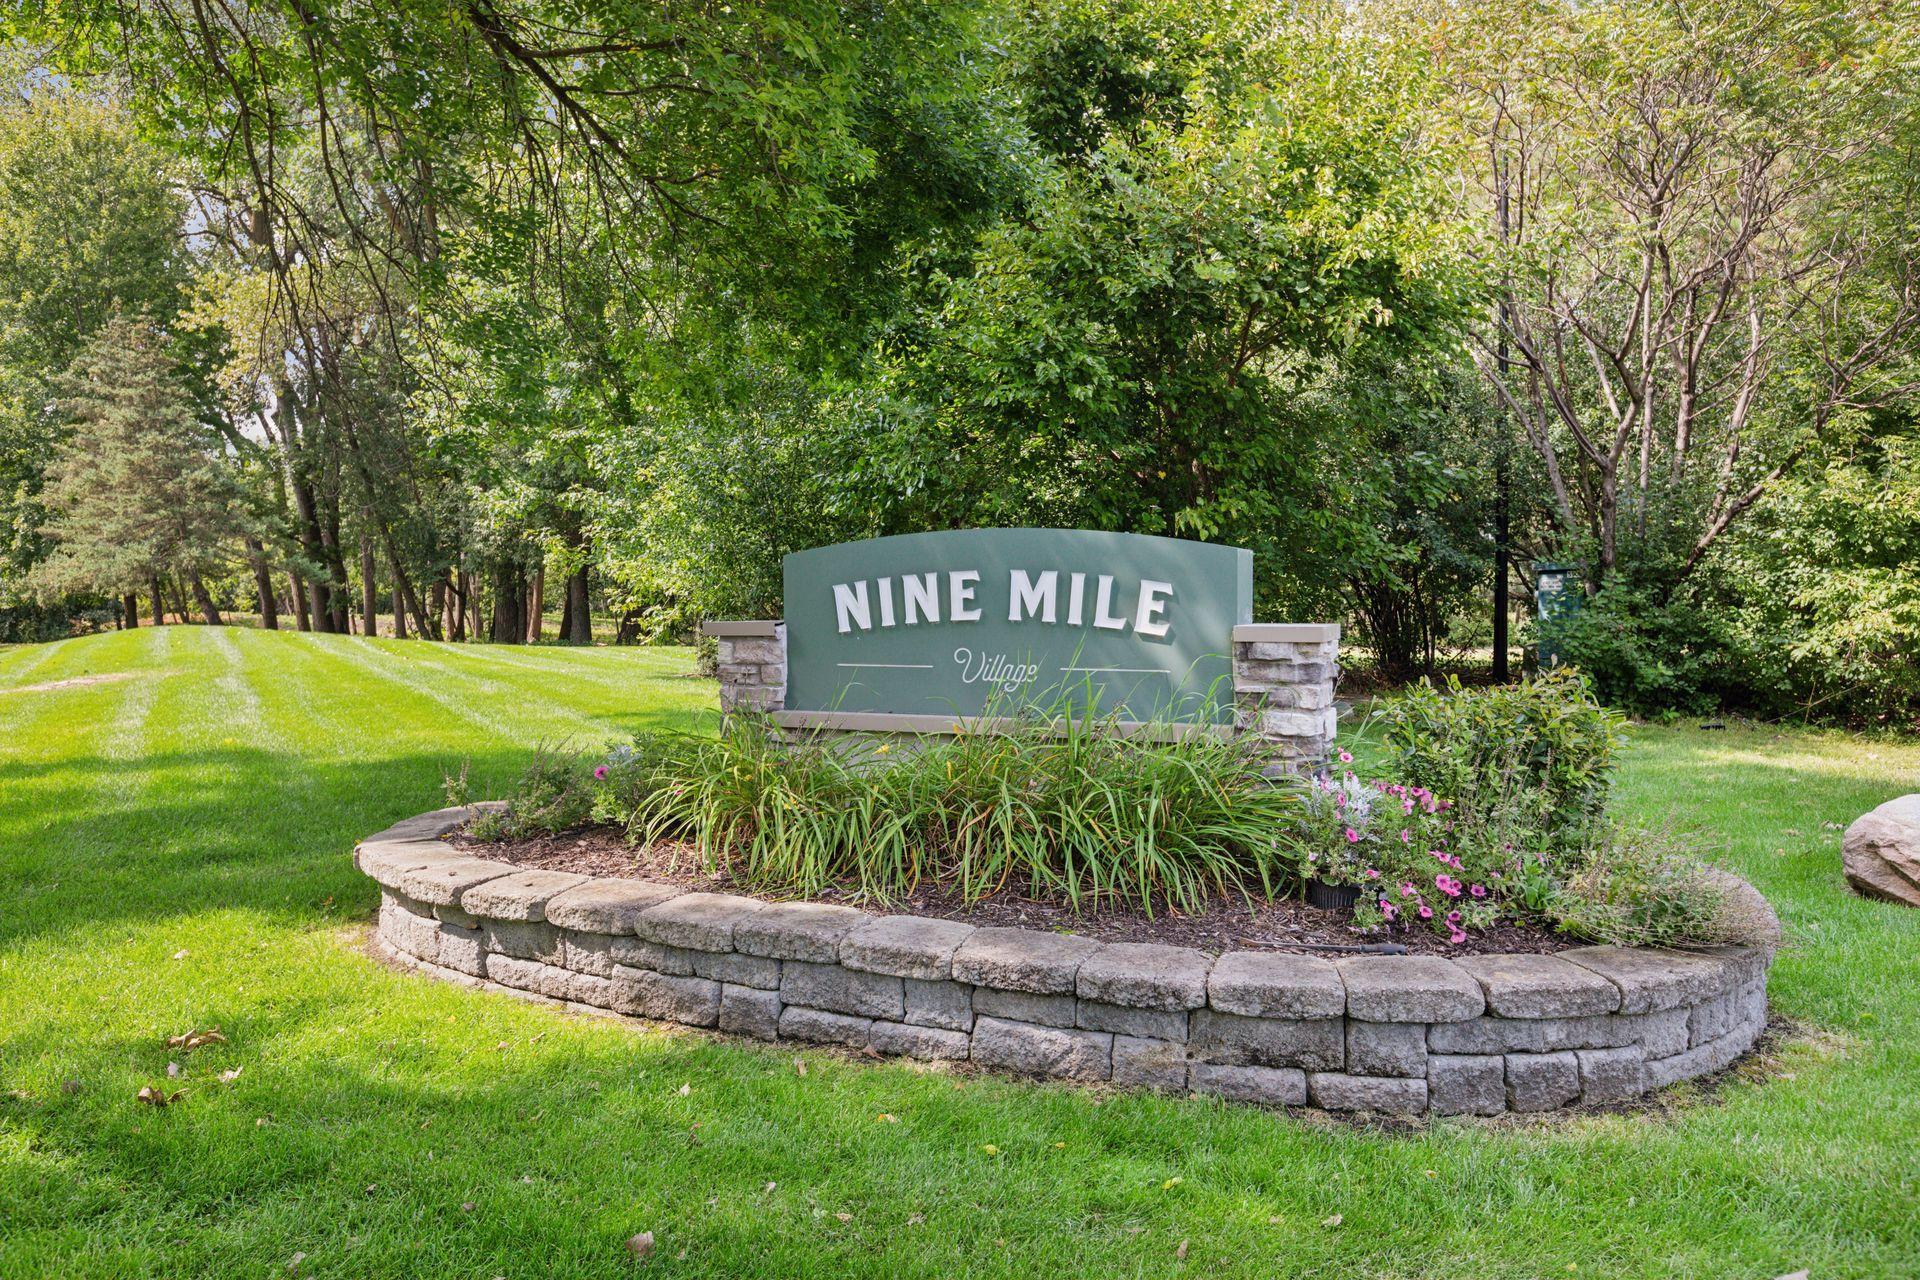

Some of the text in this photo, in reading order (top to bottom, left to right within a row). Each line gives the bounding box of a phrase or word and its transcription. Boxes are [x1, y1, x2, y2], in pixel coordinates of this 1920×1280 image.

[832, 569, 1174, 637] NINE MILE
[953, 647, 1038, 692] Village
